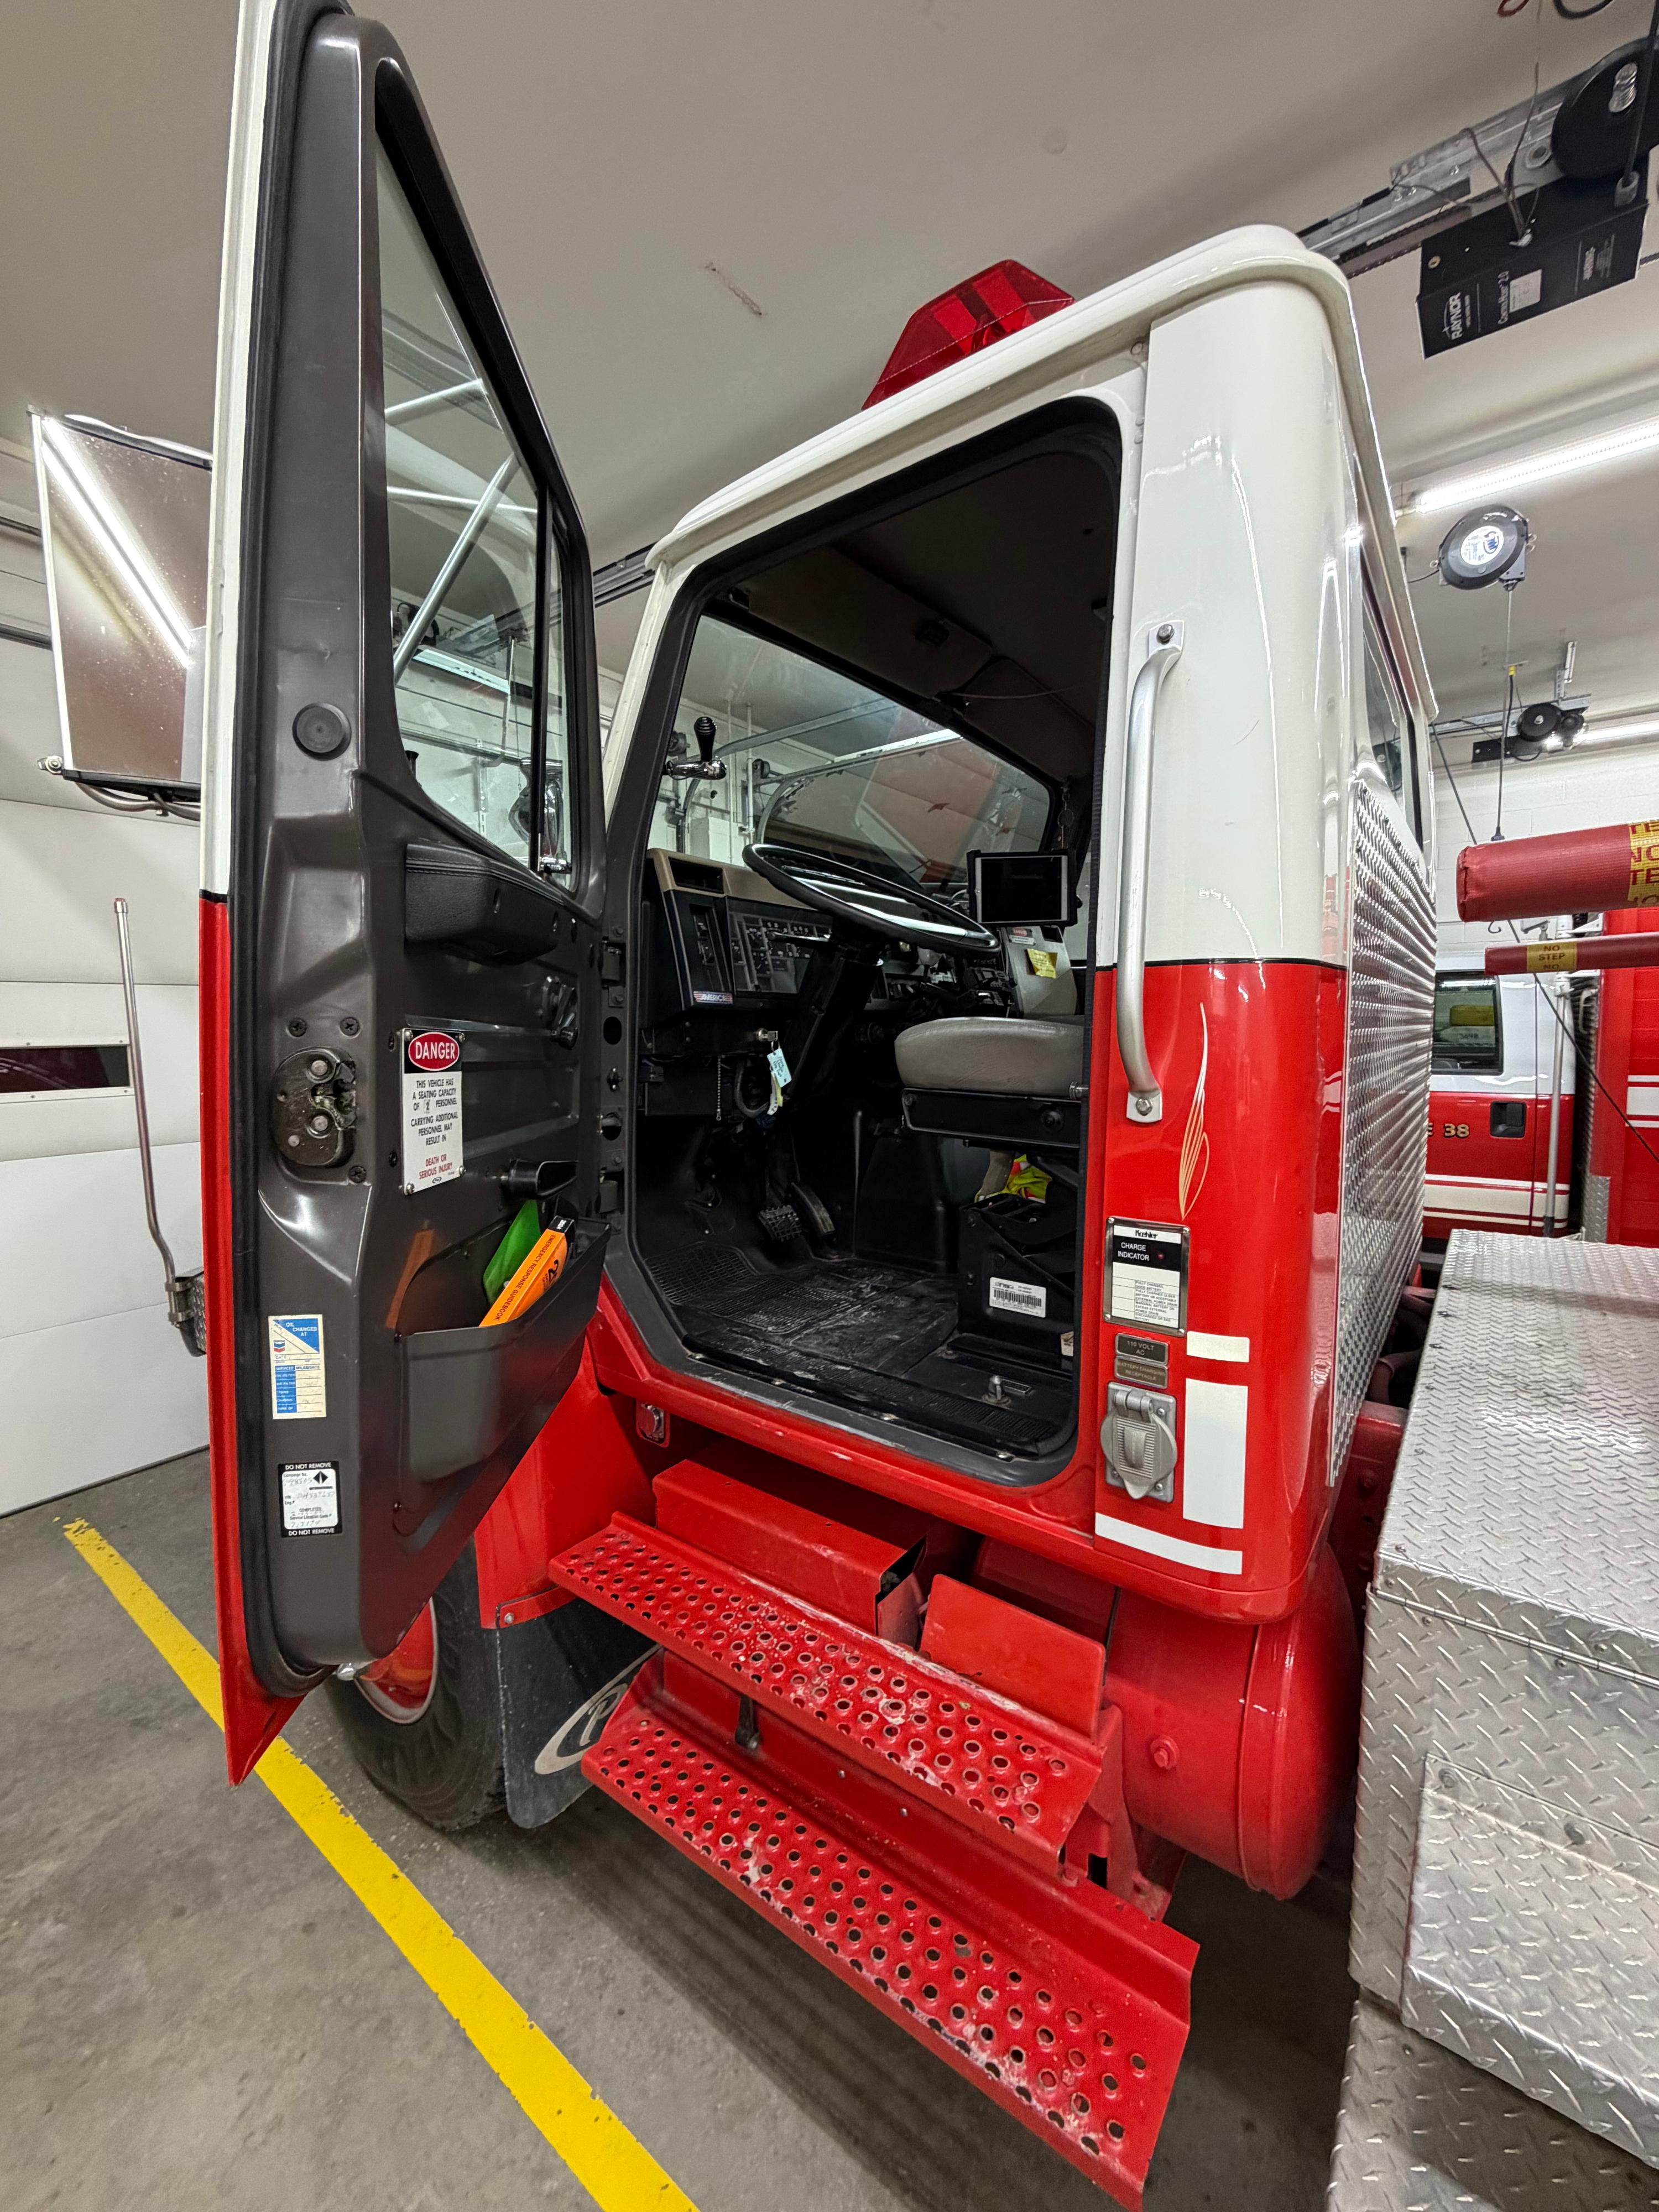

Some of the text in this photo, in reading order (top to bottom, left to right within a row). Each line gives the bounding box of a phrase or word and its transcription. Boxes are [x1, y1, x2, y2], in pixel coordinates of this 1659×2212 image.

[1449, 292, 1463, 340] RAYNOR
[415, 1041, 456, 1059] DANGER
[416, 1080, 426, 1088] THIS
[428, 1079, 444, 1087] VEHICLE
[413, 1088, 456, 1100] A SEATING CAPACITY
[426, 1102, 430, 1110] 2
[436, 1098, 457, 1107] PERSONNEL
[411, 1112, 458, 1127] CARRYING ADDITIONAL
[419, 1123, 452, 1136] PERSONNEL MAY
[1443, 1123, 1470, 1139] 38
[426, 1135, 440, 1145] RESULT
[426, 1154, 447, 1166] DEATH OR
[419, 1162, 452, 1180] SERIOUS INJURY
[1121, 1242, 1146, 1251] CHARGE
[1118, 1251, 1150, 1261] INDICATOR
[493, 1235, 556, 1321] EMERGENCY RESPONSE GUIDEBOOK
